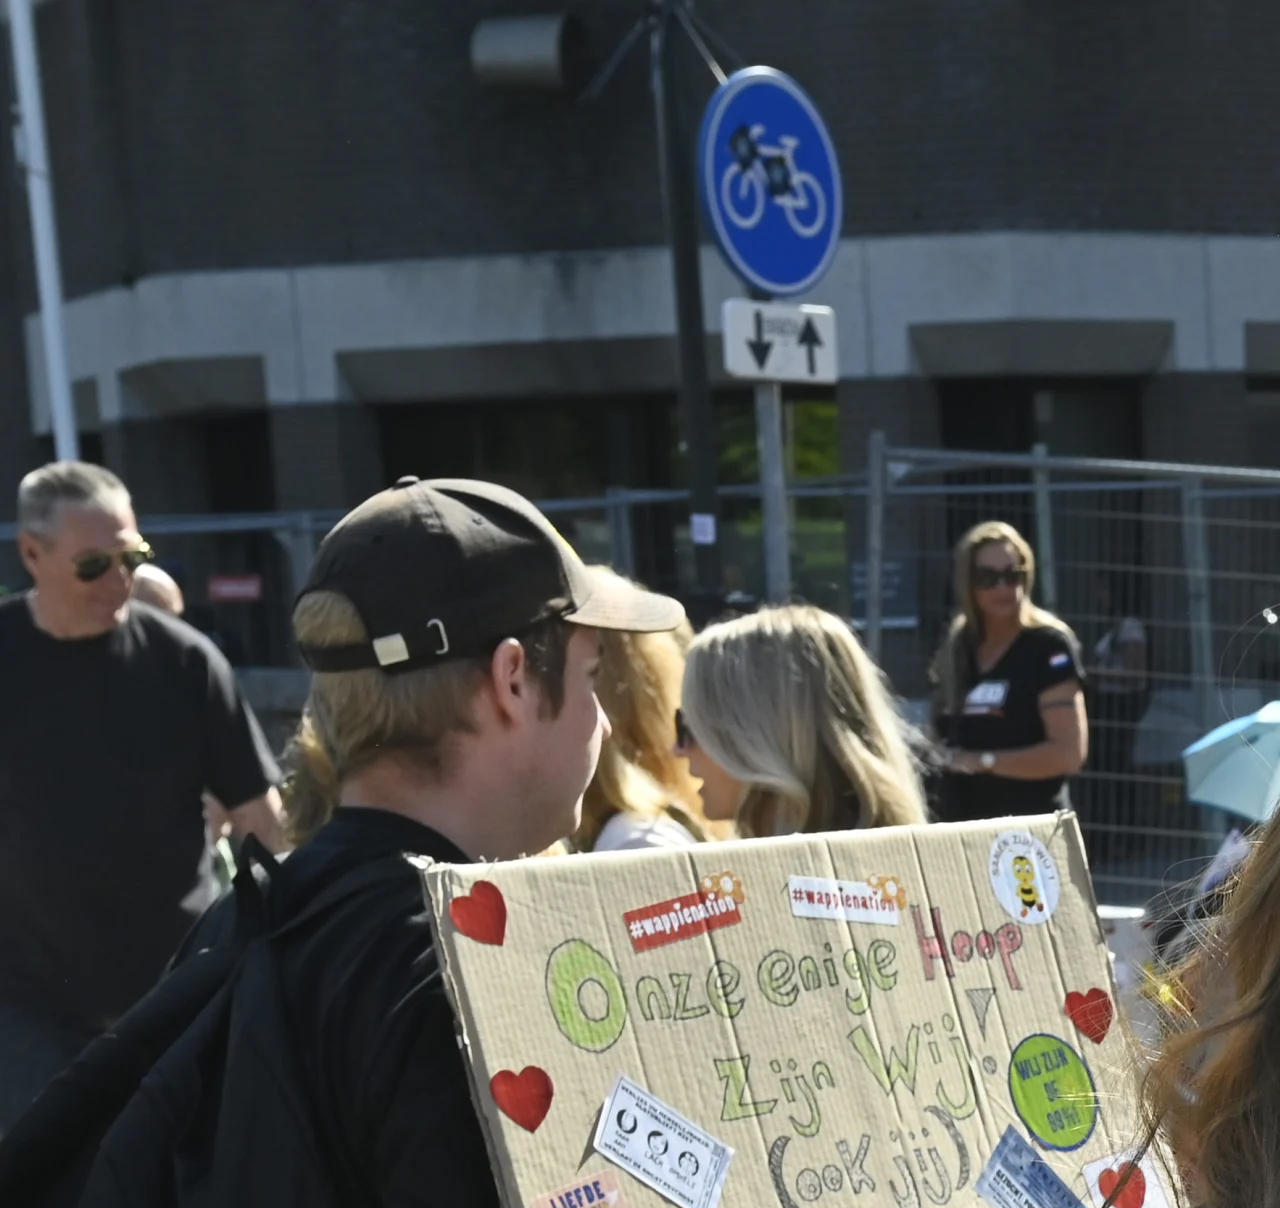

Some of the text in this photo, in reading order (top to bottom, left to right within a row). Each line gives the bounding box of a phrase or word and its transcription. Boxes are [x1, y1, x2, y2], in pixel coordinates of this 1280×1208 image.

[629, 892, 737, 940] #wappienation
[792, 887, 896, 912] #wappienation
[545, 904, 1024, 1053] Onze enige Hoop
[1014, 1046, 1069, 1081] WIJ ZIJN
[713, 1053, 836, 1138] Zijn
